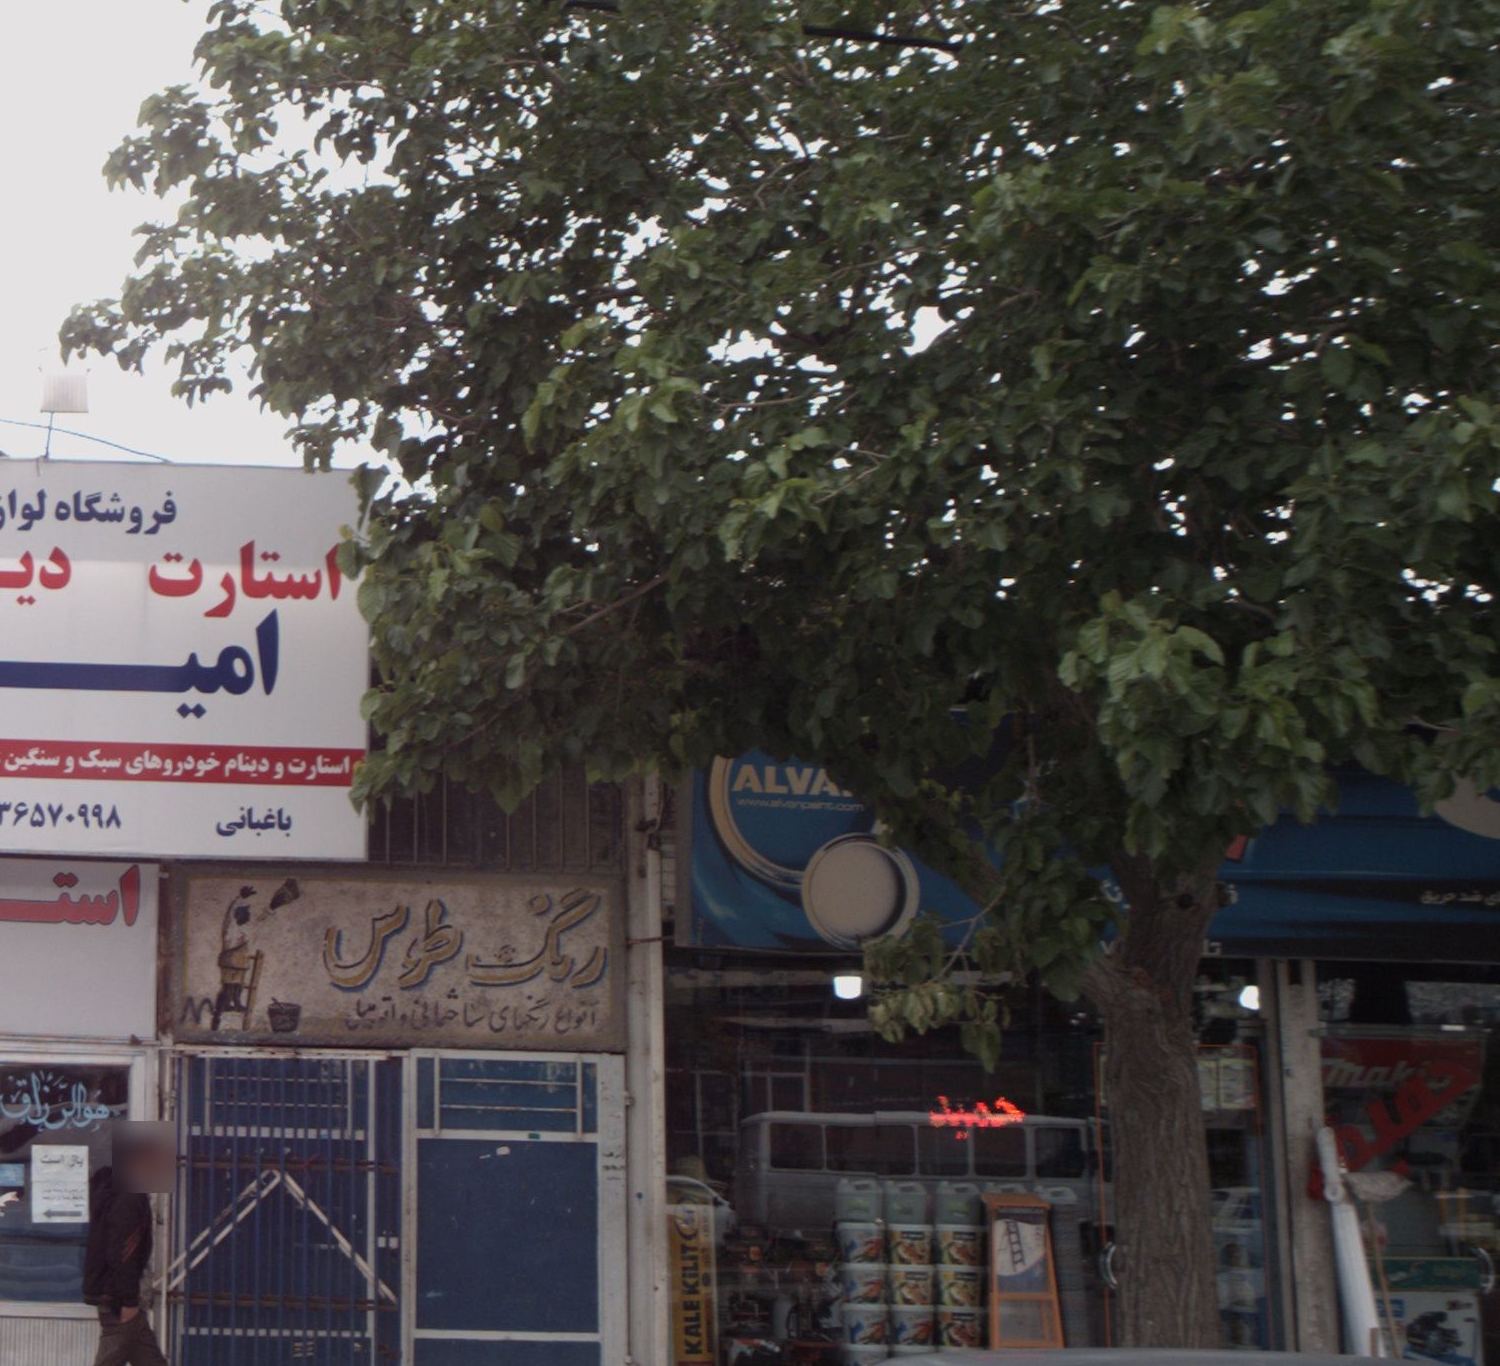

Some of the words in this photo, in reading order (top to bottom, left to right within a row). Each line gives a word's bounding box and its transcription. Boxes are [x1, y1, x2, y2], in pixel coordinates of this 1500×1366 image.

[55, 489, 177, 534] فروشگاه
[148, 540, 342, 618] استارت
[4, 747, 60, 771] سنگین
[63, 756, 75, 773] و
[78, 748, 122, 769] سبک
[124, 750, 221, 777] خودروهای
[224, 752, 269, 777] دینام
[273, 762, 284, 778] و
[288, 755, 350, 779] استارت
[732, 764, 852, 797] ALVA
[216, 806, 292, 836] باغبانی
[679, 1242, 701, 1295] KILIT
[682, 1300, 704, 1356] KALE
